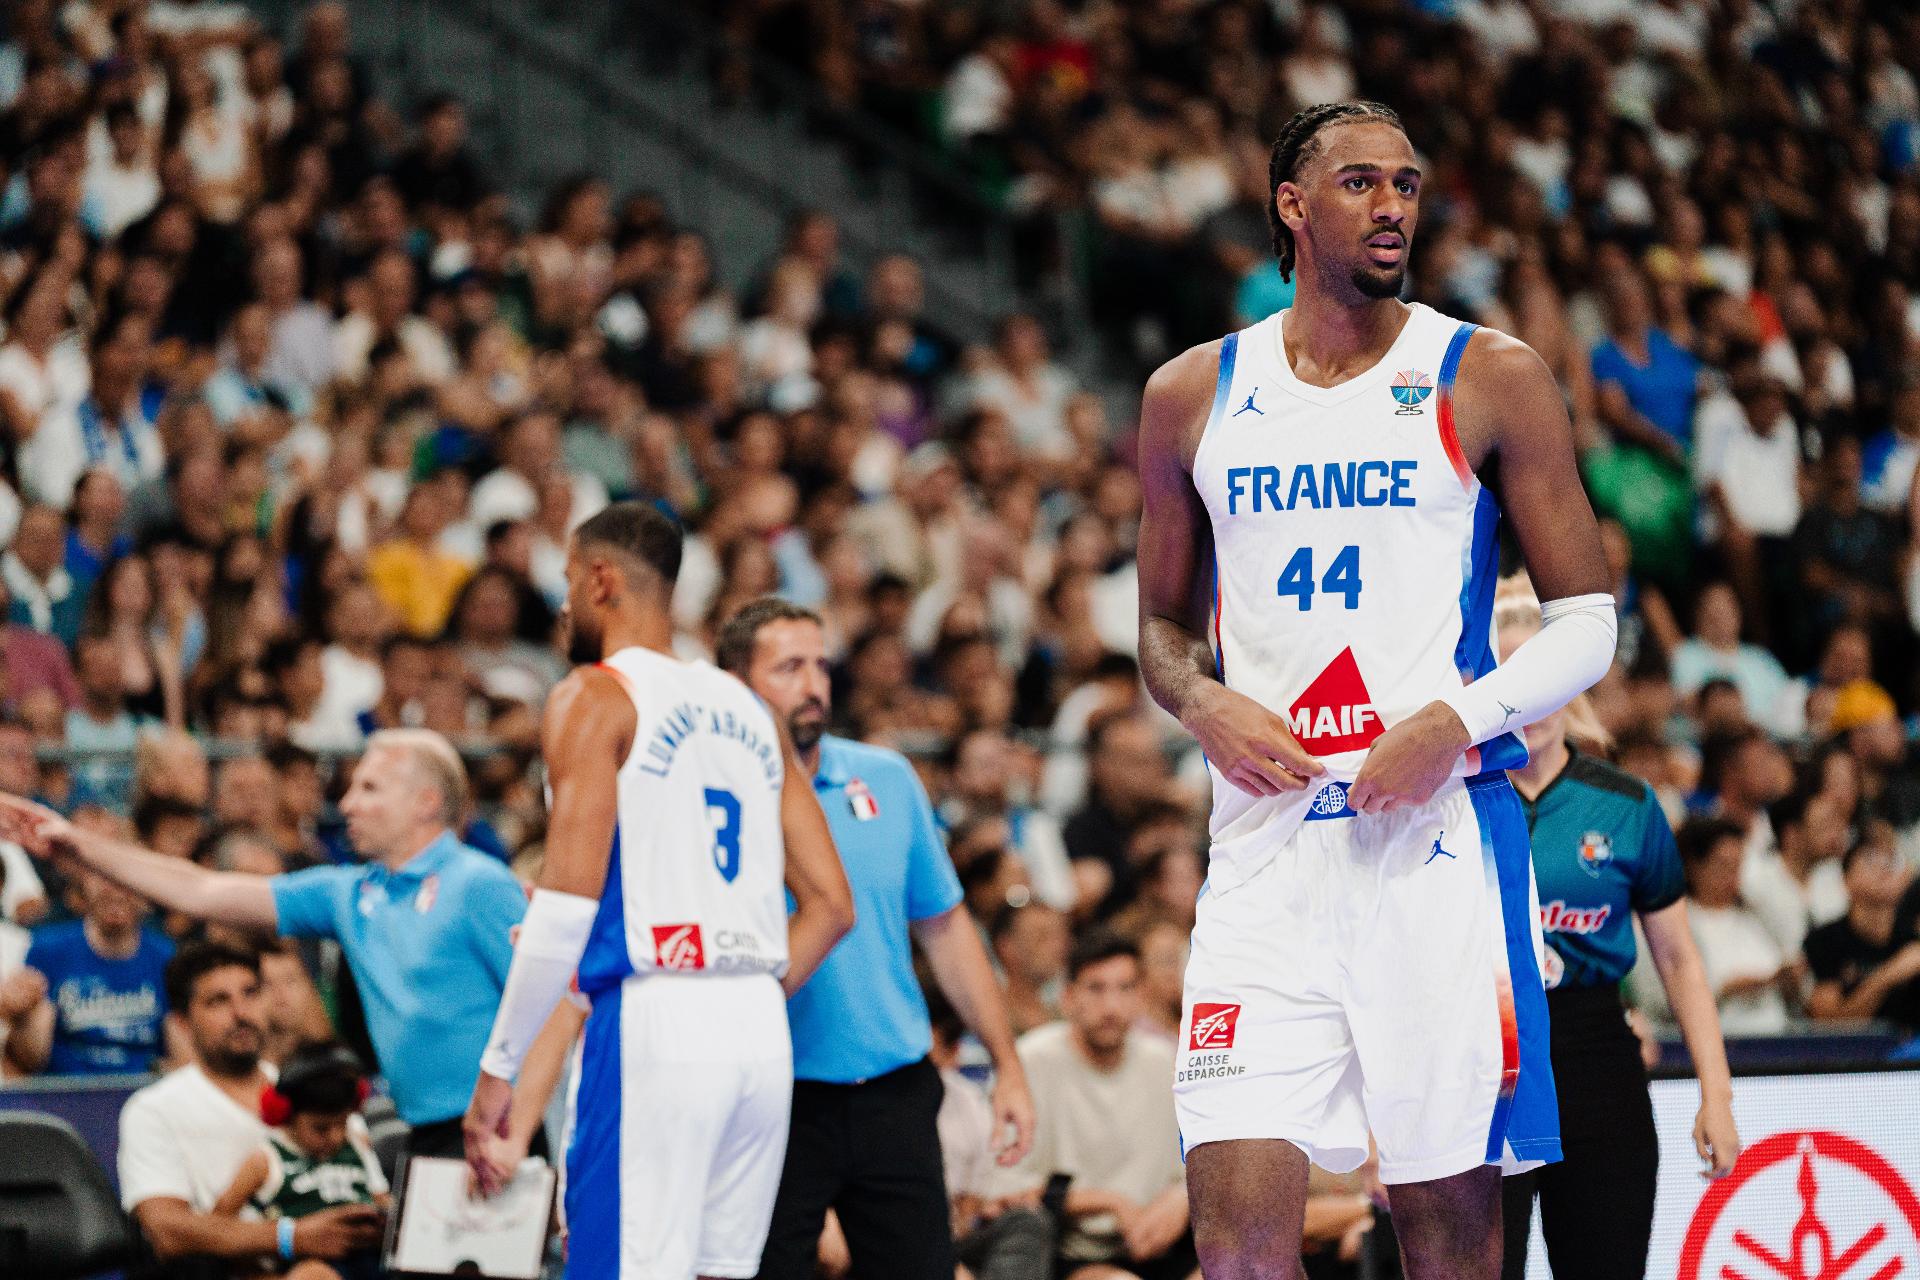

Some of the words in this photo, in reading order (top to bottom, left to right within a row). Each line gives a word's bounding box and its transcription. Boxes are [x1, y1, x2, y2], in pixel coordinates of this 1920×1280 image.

[1228, 460, 1418, 515] FRANCE
[1277, 545, 1363, 612] 44
[1287, 704, 1376, 739] MAIF
[703, 786, 742, 884] 3
[1188, 1054, 1230, 1068] CAISSE
